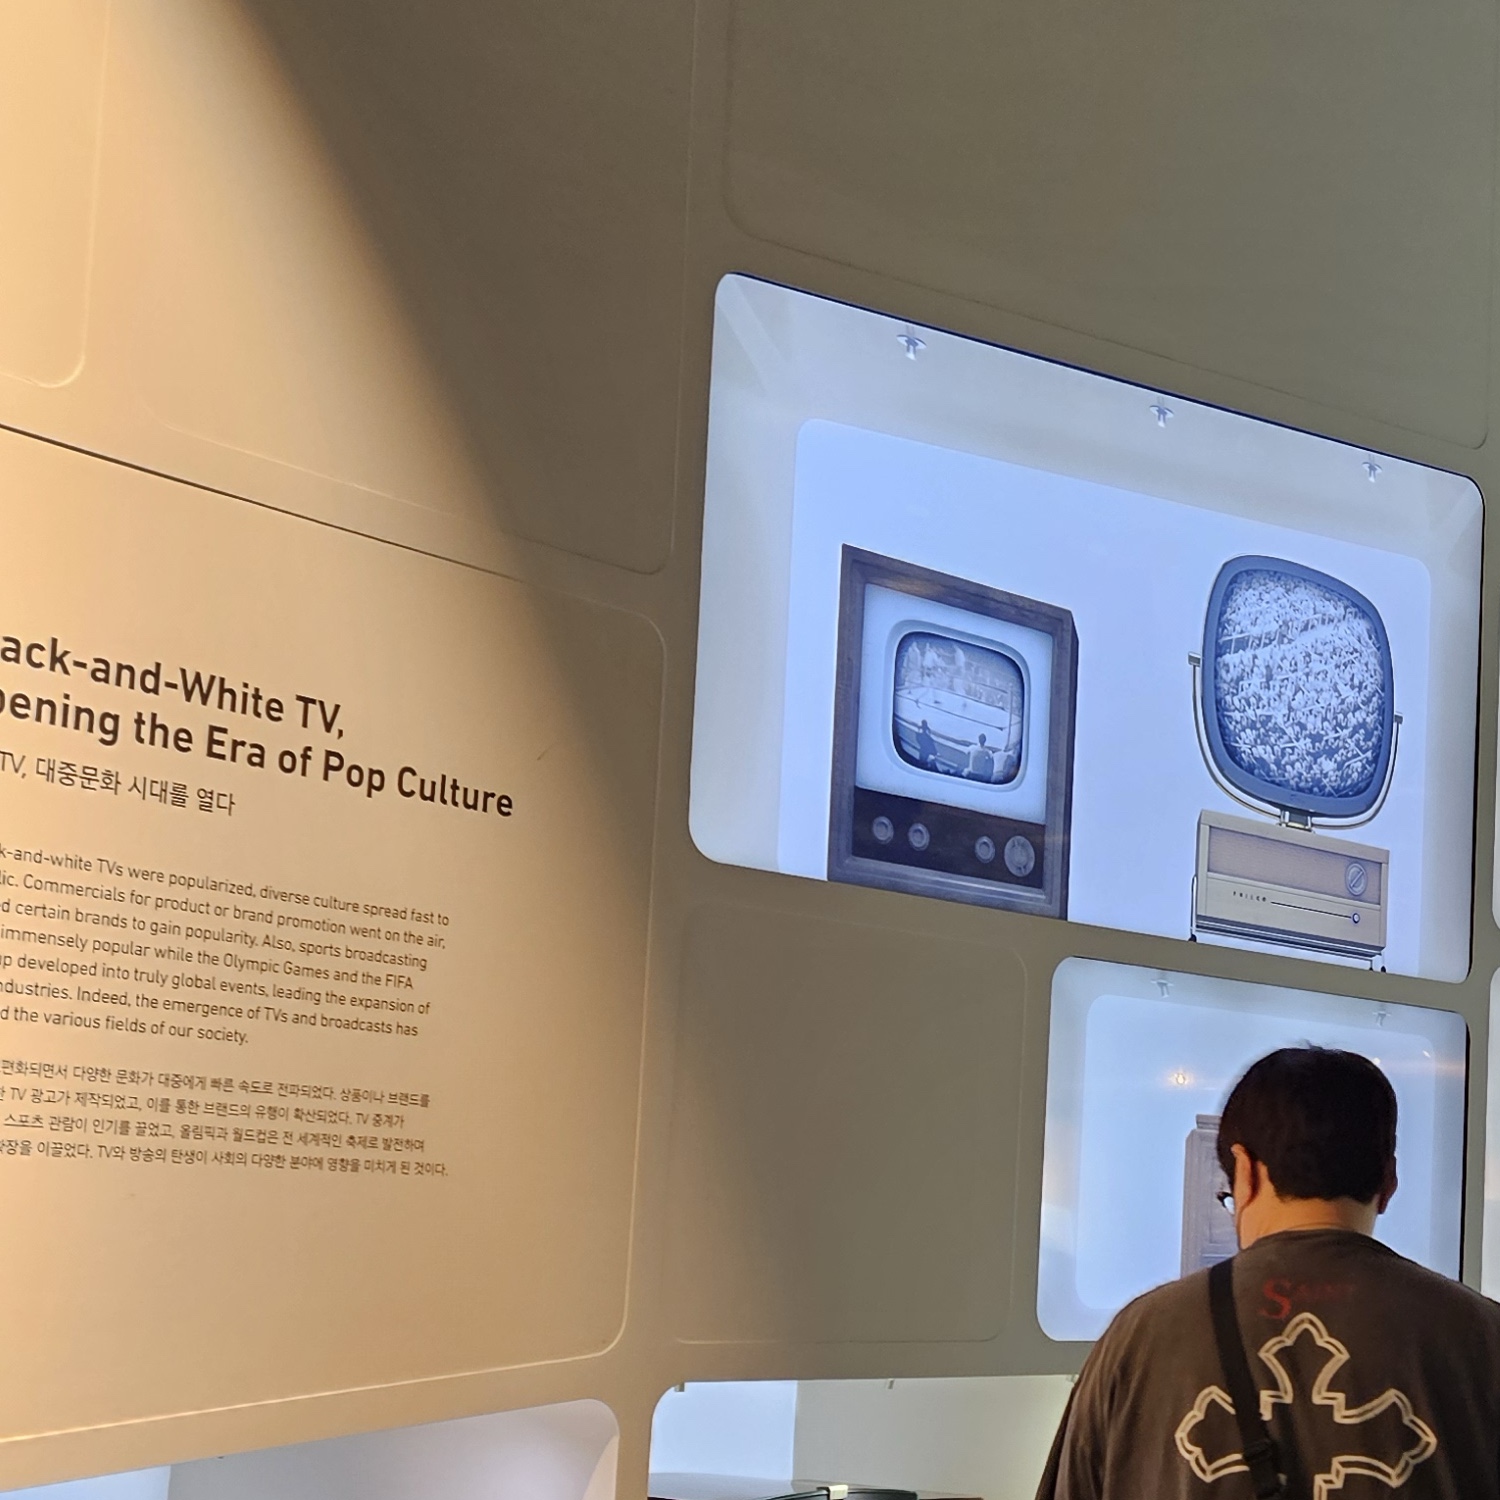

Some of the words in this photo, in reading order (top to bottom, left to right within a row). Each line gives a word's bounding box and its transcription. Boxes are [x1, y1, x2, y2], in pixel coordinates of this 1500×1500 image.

[0, 636, 284, 723] ack-and-White
[295, 694, 344, 740] TV,
[0, 751, 26, 779] TV,
[35, 757, 122, 795] 대중문화
[127, 775, 190, 808] 시대를
[197, 787, 236, 816] 열다
[133, 711, 194, 753] the
[206, 724, 266, 769] Era
[278, 746, 313, 777] of
[322, 749, 385, 798] Pop
[397, 766, 514, 817] Culture
[23, 873, 126, 903] Commercials
[129, 889, 152, 906] for
[154, 897, 211, 915] product
[213, 905, 230, 917] or
[233, 904, 273, 925] brand
[277, 915, 346, 935] promotion
[349, 925, 382, 940] went
[384, 930, 401, 942] on
[403, 930, 424, 946] the
[427, 933, 446, 950] air,
[96, 857, 124, 877] TVs
[127, 867, 165, 883] were
[168, 873, 257, 898] popularized,
[259, 885, 310, 906] diverse
[313, 895, 360, 913] culture
[362, 903, 408, 921] spread
[410, 908, 435, 925] fast
[437, 913, 450, 927] to
[0, 923, 89, 953] immensely
[91, 939, 151, 957] popular
[153, 945, 193, 963] while
[197, 950, 220, 966] the
[223, 952, 280, 974] Olympic
[283, 960, 330, 980] Games
[333, 970, 359, 983] and
[361, 971, 382, 986] the
[385, 973, 414, 989] FIFA
[15, 903, 71, 921] certain
[75, 907, 128, 929] brands
[132, 916, 146, 931] to
[149, 920, 181, 936] gain
[185, 926, 259, 949] popularity.
[261, 934, 296, 953] Also,
[298, 942, 341, 958] sports
[344, 946, 428, 972] broadcasting
[17, 953, 98, 977] developed
[101, 962, 130, 981] into
[133, 967, 169, 988] truly
[171, 972, 217, 991] global
[219, 980, 269, 997] events,
[272, 983, 322, 1006] leading
[325, 991, 347, 1006] the
[349, 996, 415, 1013] expansion
[417, 1001, 431, 1015] of
[77, 985, 131, 1007] Indeed,
[135, 993, 159, 1009] the
[162, 999, 243, 1019] emergence
[246, 1005, 261, 1020] of
[263, 1006, 289, 1023] TVs
[291, 1013, 317, 1027] and
[320, 1013, 393, 1035] broadcasts
[395, 1021, 419, 1037] has
[13, 1006, 39, 1023] the
[43, 1011, 101, 1029] various
[105, 1015, 147, 1034] fields
[150, 1020, 166, 1035] of
[168, 1025, 194, 1038] our
[197, 1026, 249, 1046] society.
[9, 1086, 27, 1101] TV
[30, 1088, 71, 1104] 광고가
[74, 1091, 142, 1111] 제작되었고,
[146, 1097, 171, 1114] 이를
[202, 1101, 251, 1118] 브랜드의
[355, 1112, 368, 1125] TV
[372, 1113, 405, 1129] 중계가
[73, 1065, 113, 1084] 다양한
[115, 1069, 155, 1087] 문화가
[157, 1073, 207, 1091] 대중에게
[237, 1079, 274, 1095] 속도로
[277, 1082, 337, 1100] 전파되었다.
[339, 1088, 386, 1103] 상품이나
[3, 1113, 45, 1129] 스포츠
[48, 1115, 88, 1133] 관람이
[92, 1118, 131, 1136] 인기를
[135, 1121, 175, 1139] 끌었고,
[282, 1131, 293, 1146] 전
[297, 1131, 342, 1149] 세계적인
[37, 1141, 93, 1159] 이끌었다.
[97, 1144, 127, 1161] TV와
[129, 1147, 167, 1163] 방송의
[171, 1149, 208, 1165] 탄생이
[211, 1151, 248, 1167] 사회의
[251, 1153, 287, 1169] 다양한
[363, 1159, 397, 1175] 미치게
[413, 1161, 449, 1177] 것이다.
